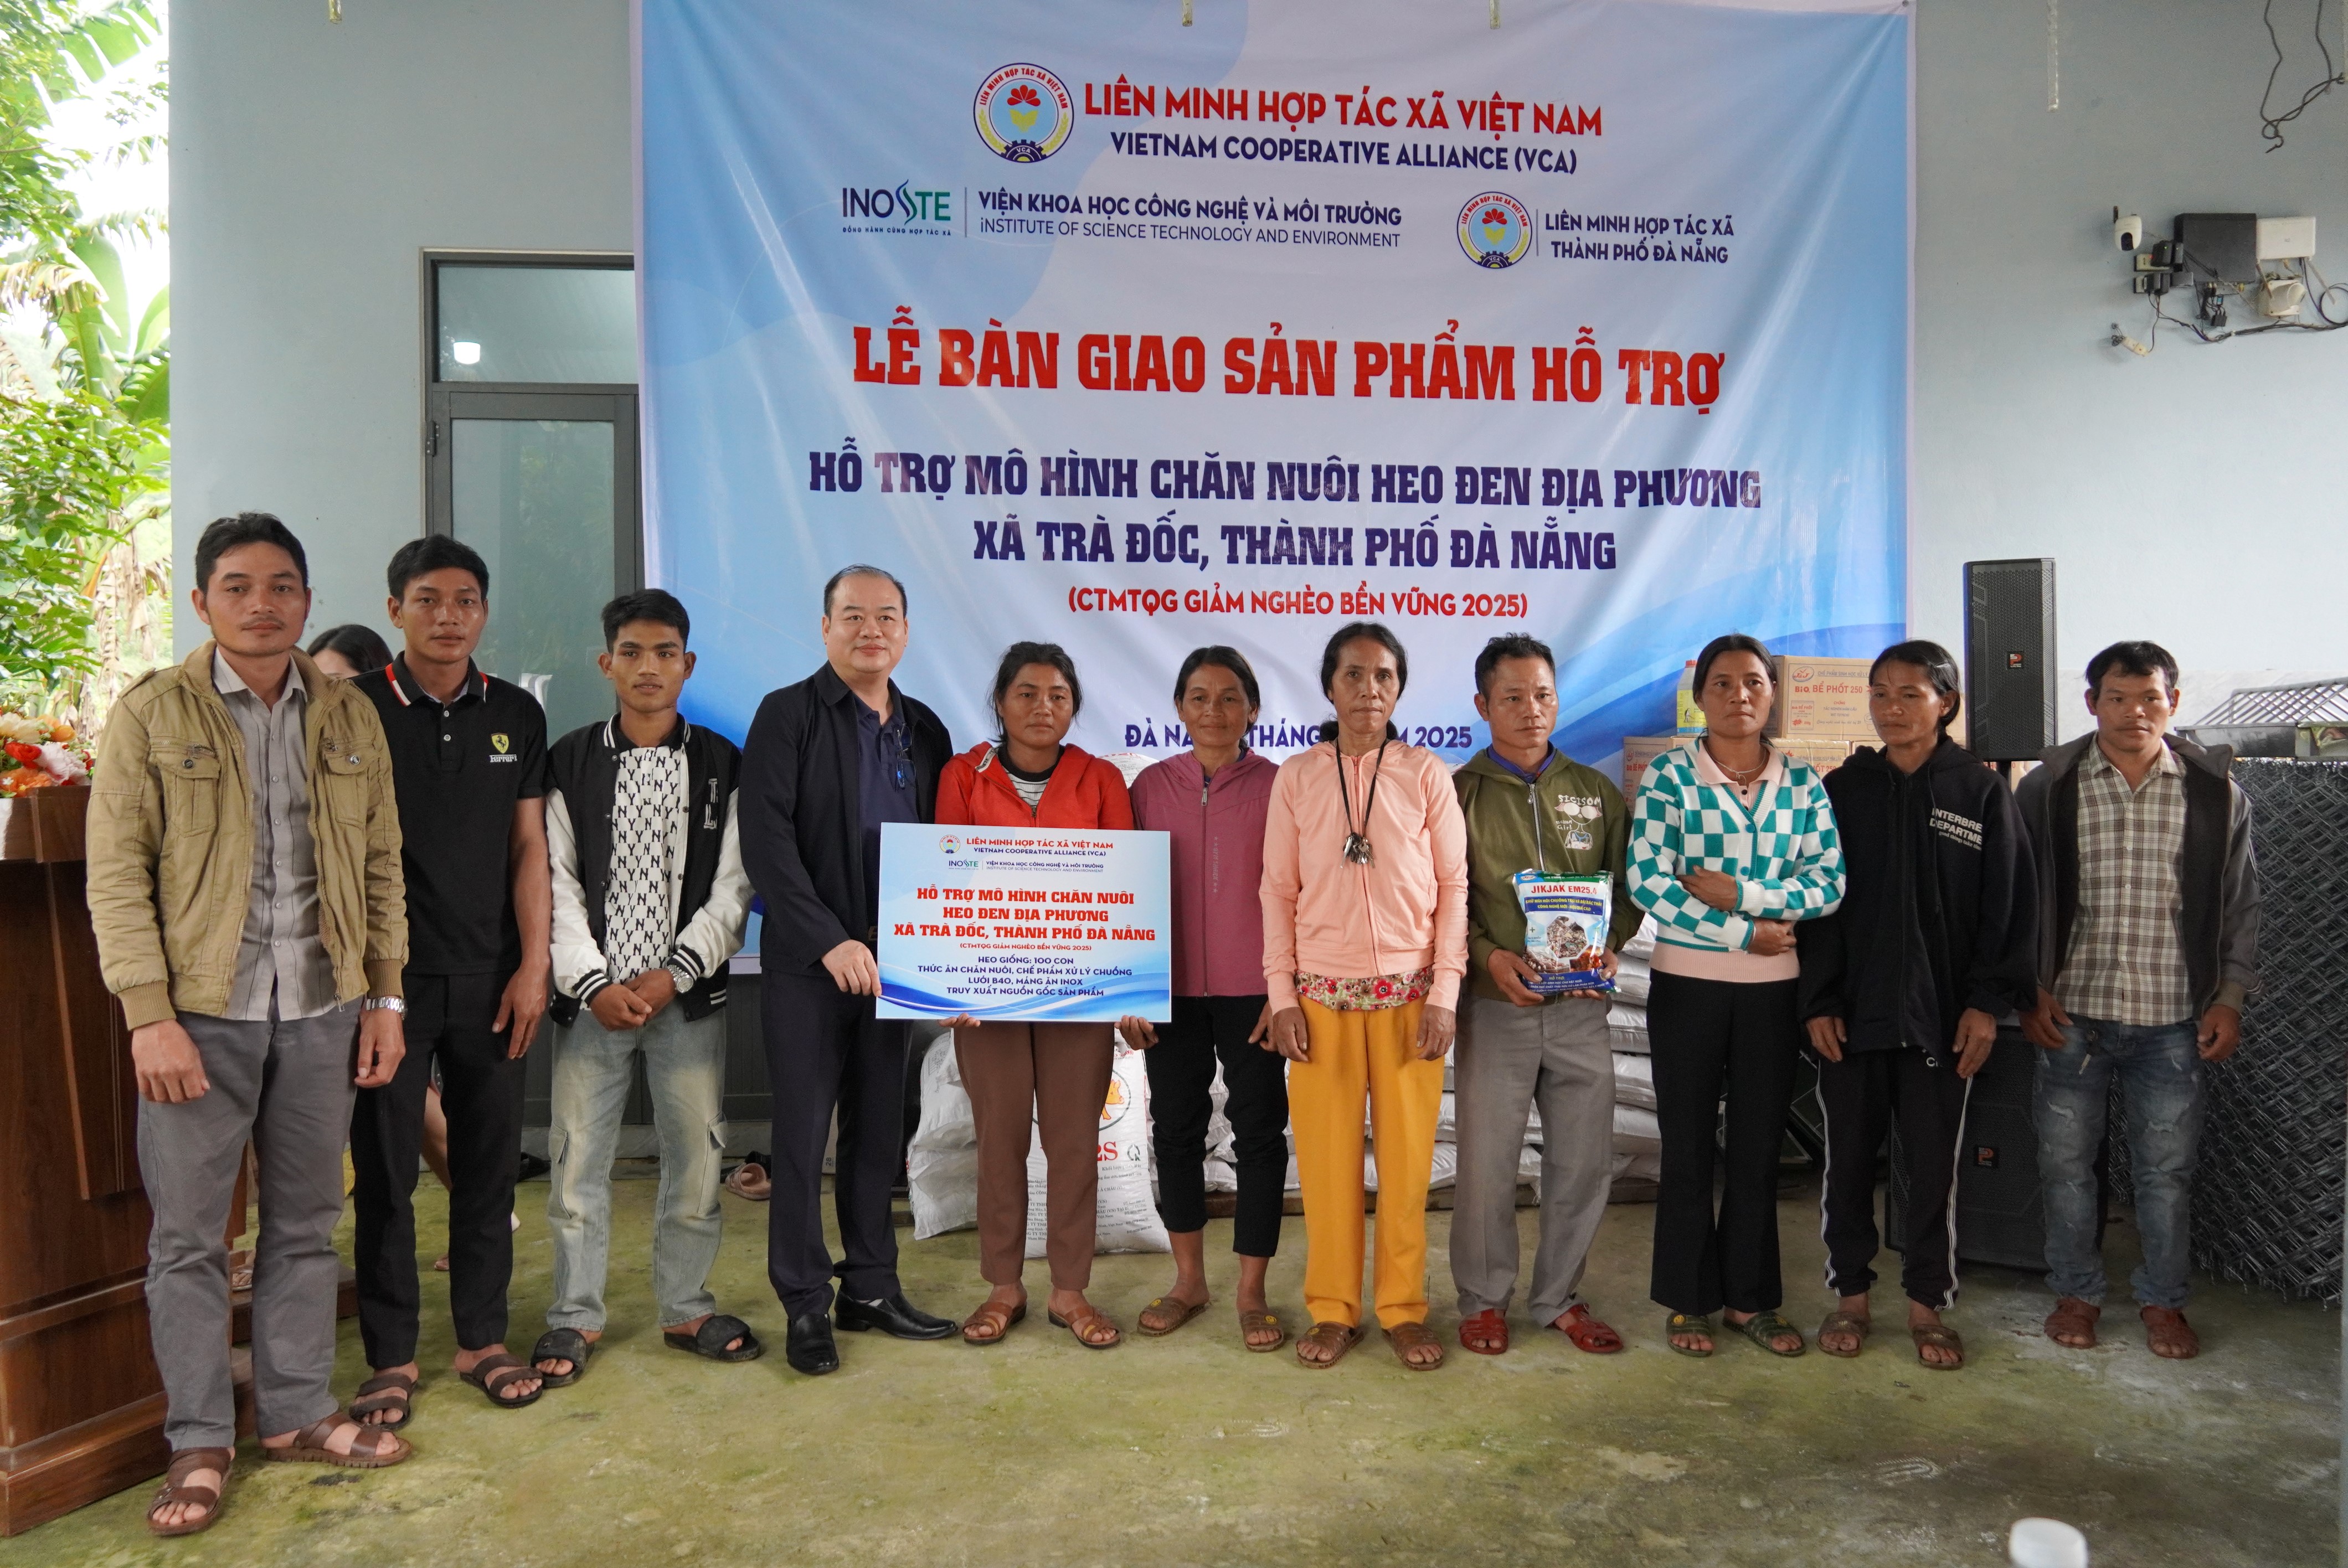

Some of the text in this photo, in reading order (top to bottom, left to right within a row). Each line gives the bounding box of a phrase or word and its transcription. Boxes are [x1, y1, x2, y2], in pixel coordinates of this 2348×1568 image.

[1085, 74, 1602, 141] LIÊN MINH HỢP TÁC XÃ VIỆT NAM
[1110, 132, 1577, 174] VIETNAM COOPERATIVE ALLIANCE (VCA)
[979, 187, 1402, 226] VIỆN KHOA HỌC CÔNG NGHỆ VÀ MÔI TRƯỜNG
[1058, 221, 1079, 235] OF
[1083, 223, 1146, 238] SCIENCE
[1150, 224, 1252, 242] TECHNOLOGY
[1255, 228, 1288, 243] AND
[1293, 230, 1400, 247] ENVIRONMENT
[1546, 209, 1734, 239] LIÊN MINH HỢP TÁC XÃ
[1551, 236, 1728, 264] THÀNH PHỐ ĐÀ NẴNG
[853, 305, 1725, 415] LỄ BÀN GIAO SẢN PHẨM HỖ TRỢ
[809, 436, 1761, 513] HỖ TRỢ MÔ HÌNH CHĂN NUÔI HEO ĐEN ĐỊA PHƯƠNG
[974, 509, 1616, 571] XÃ TRÀ ĐỐC, THÀNH PHỐ ĐÀ NẴNG
[1069, 581, 1527, 618] (CTMTQG GIẢM NGHÈO BỀN VỮNG 2025)
[1813, 681, 1824, 693] BỂ
[1827, 683, 1849, 693] PHỐT
[1125, 718, 1158, 747] ĐÀ
[1413, 726, 1472, 748] 2025
[490, 754, 517, 762] Ferrari
[967, 837, 986, 845] LIÊN
[1037, 839, 1054, 847] TÁC
[1072, 840, 1091, 849] VIỆT
[917, 884, 1134, 904] HỖ TRỢ MÔ HÌNH CHĂN NUÔI
[1531, 885, 1565, 894] JIKJAK
[943, 907, 1109, 922] HEO ĐEN ĐỊA PHƯƠNG
[894, 921, 1155, 940] XÃ TRÀ ĐỐC, THÀNH PHỐ ĐÀ NẴNG
[918, 964, 943, 972] THỨC
[945, 964, 957, 973] ĂN
[960, 965, 986, 973] CHĂN
[989, 965, 1014, 974] NUÔI,
[1017, 965, 1034, 974] CHẾ
[1037, 964, 1063, 974] PHẨM
[1065, 966, 1078, 974] XỬ
[1080, 967, 1090, 975] LÝ
[1000, 954, 1032, 963] GIỐNG:
[969, 976, 990, 984] LƯỚI
[973, 984, 997, 994] XUẤT
[1036, 986, 1055, 995] GỐC
[1058, 987, 1076, 996] SẢN
[1079, 986, 1104, 996] PHẨM
